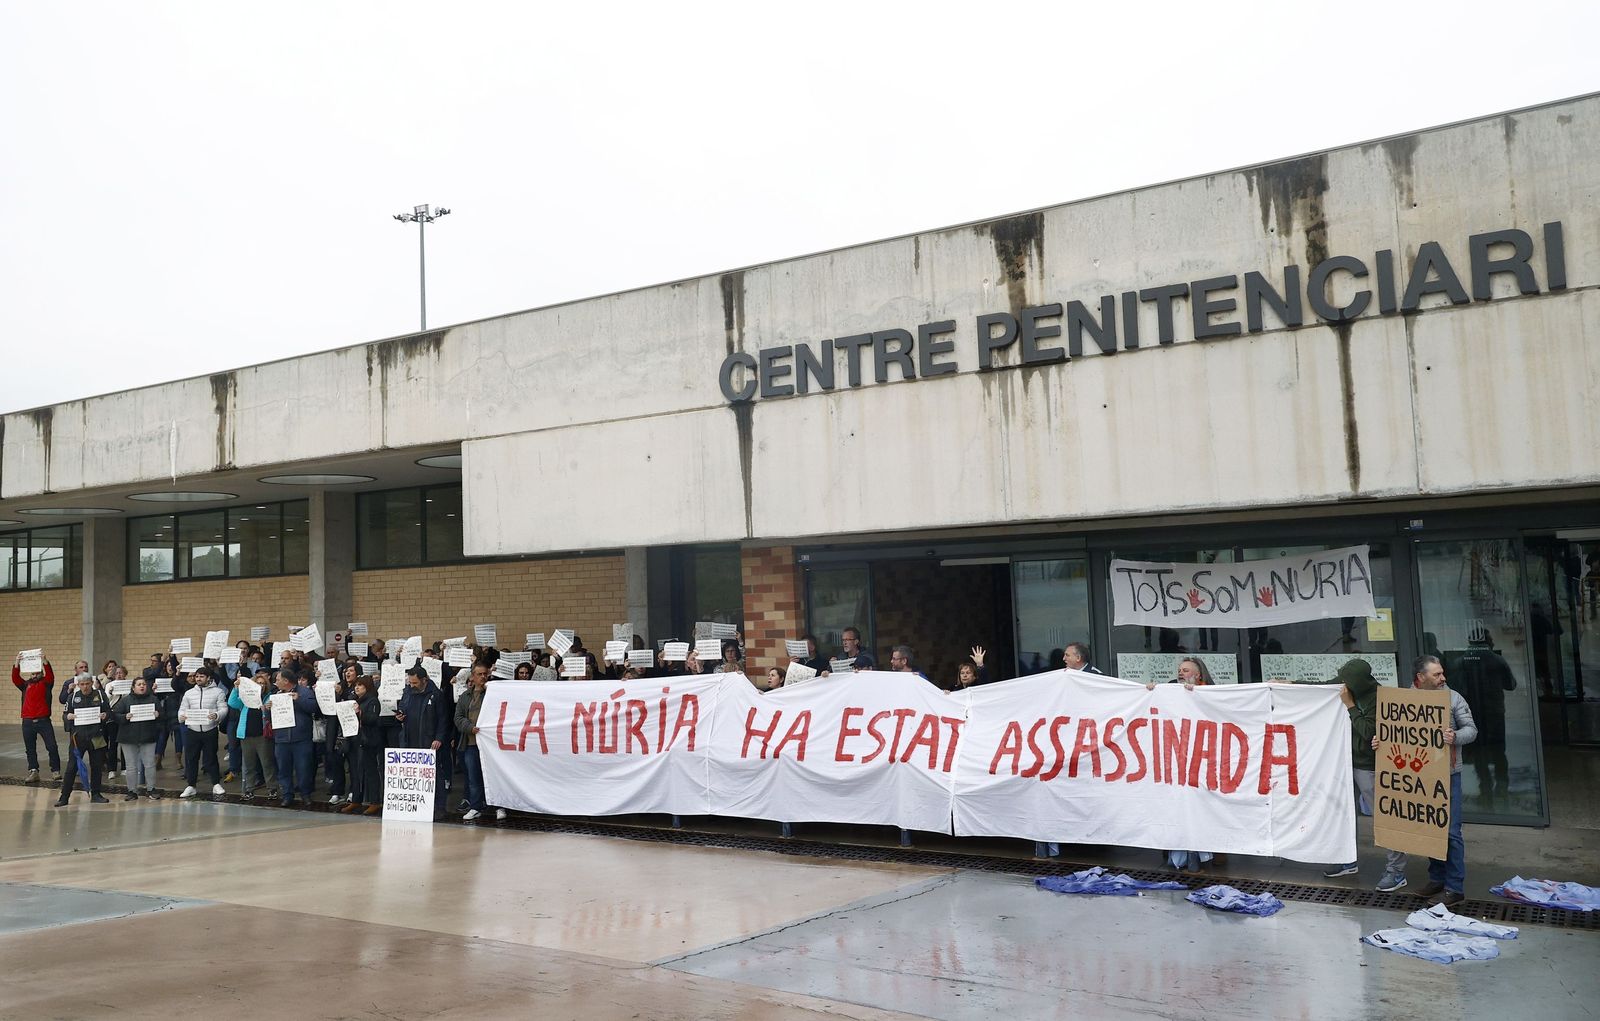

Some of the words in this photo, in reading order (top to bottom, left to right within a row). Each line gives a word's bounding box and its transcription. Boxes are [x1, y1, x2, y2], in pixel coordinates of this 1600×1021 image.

[719, 320, 957, 403] CENTRE
[979, 221, 1566, 369] PENITENCIARI
[1271, 553, 1371, 606] NÚRIA
[1381, 702, 1445, 725] UBASART
[496, 702, 548, 754] LA
[571, 686, 699, 755] NÚRIA
[741, 707, 811, 761] HA
[835, 707, 966, 773] ESTAT
[989, 707, 1299, 795] ASSASSINADA
[1380, 723, 1445, 749] DIMISSIÓ
[387, 751, 400, 764] SIN
[402, 752, 436, 766] SEGURIDAD
[387, 766, 397, 776] NO
[400, 767, 417, 777] PUEDE
[419, 768, 435, 778] HABER
[387, 793, 426, 803] CONSEJERA
[1380, 771, 1426, 796] CESA
[1433, 780, 1448, 800] A
[1379, 796, 1448, 828] CALDERÓ
